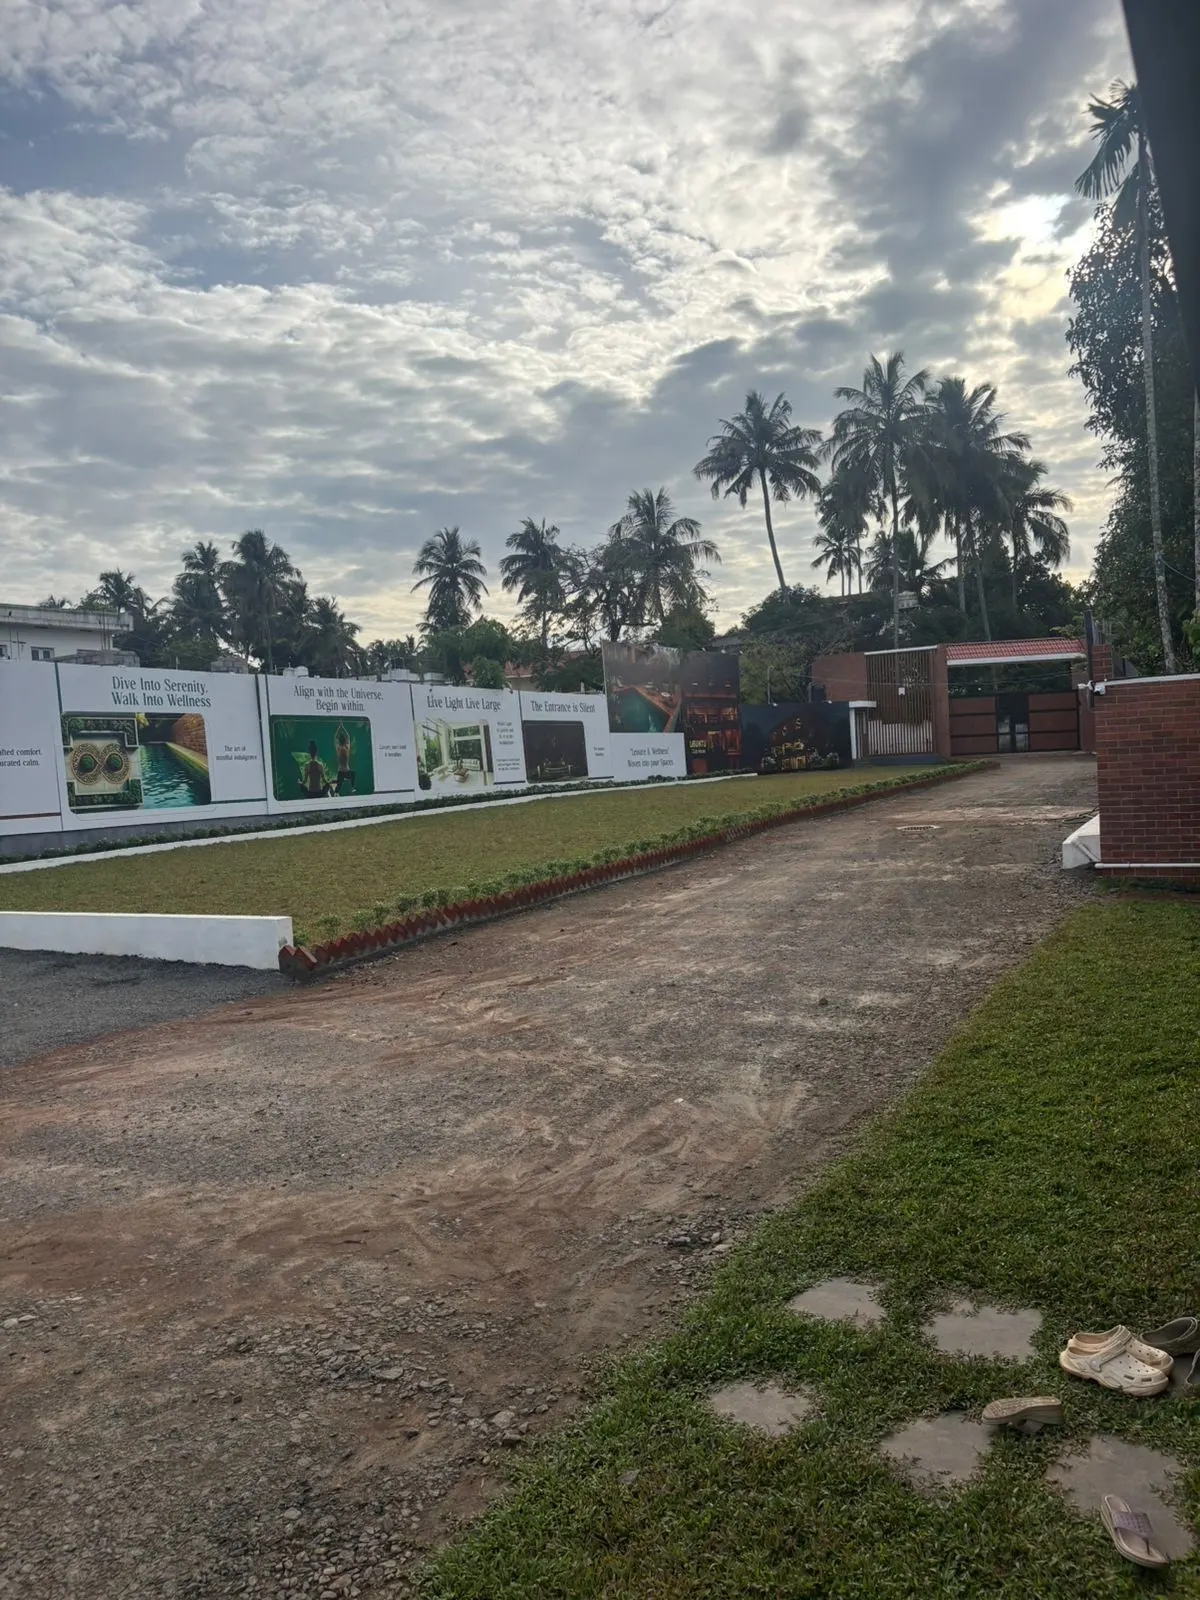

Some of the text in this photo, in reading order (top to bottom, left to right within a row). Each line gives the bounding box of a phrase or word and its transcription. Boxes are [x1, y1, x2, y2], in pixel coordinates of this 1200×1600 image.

[112, 676, 136, 690] Dive
[140, 678, 160, 691] Into
[294, 685, 314, 699] Align
[317, 686, 334, 698] with
[337, 688, 348, 699] the
[112, 692, 211, 707] Walk Into Wellness
[316, 700, 366, 712] Begin within.
[427, 695, 501, 712] Live Light Live Large
[531, 701, 596, 712] The Entrance is Silent
